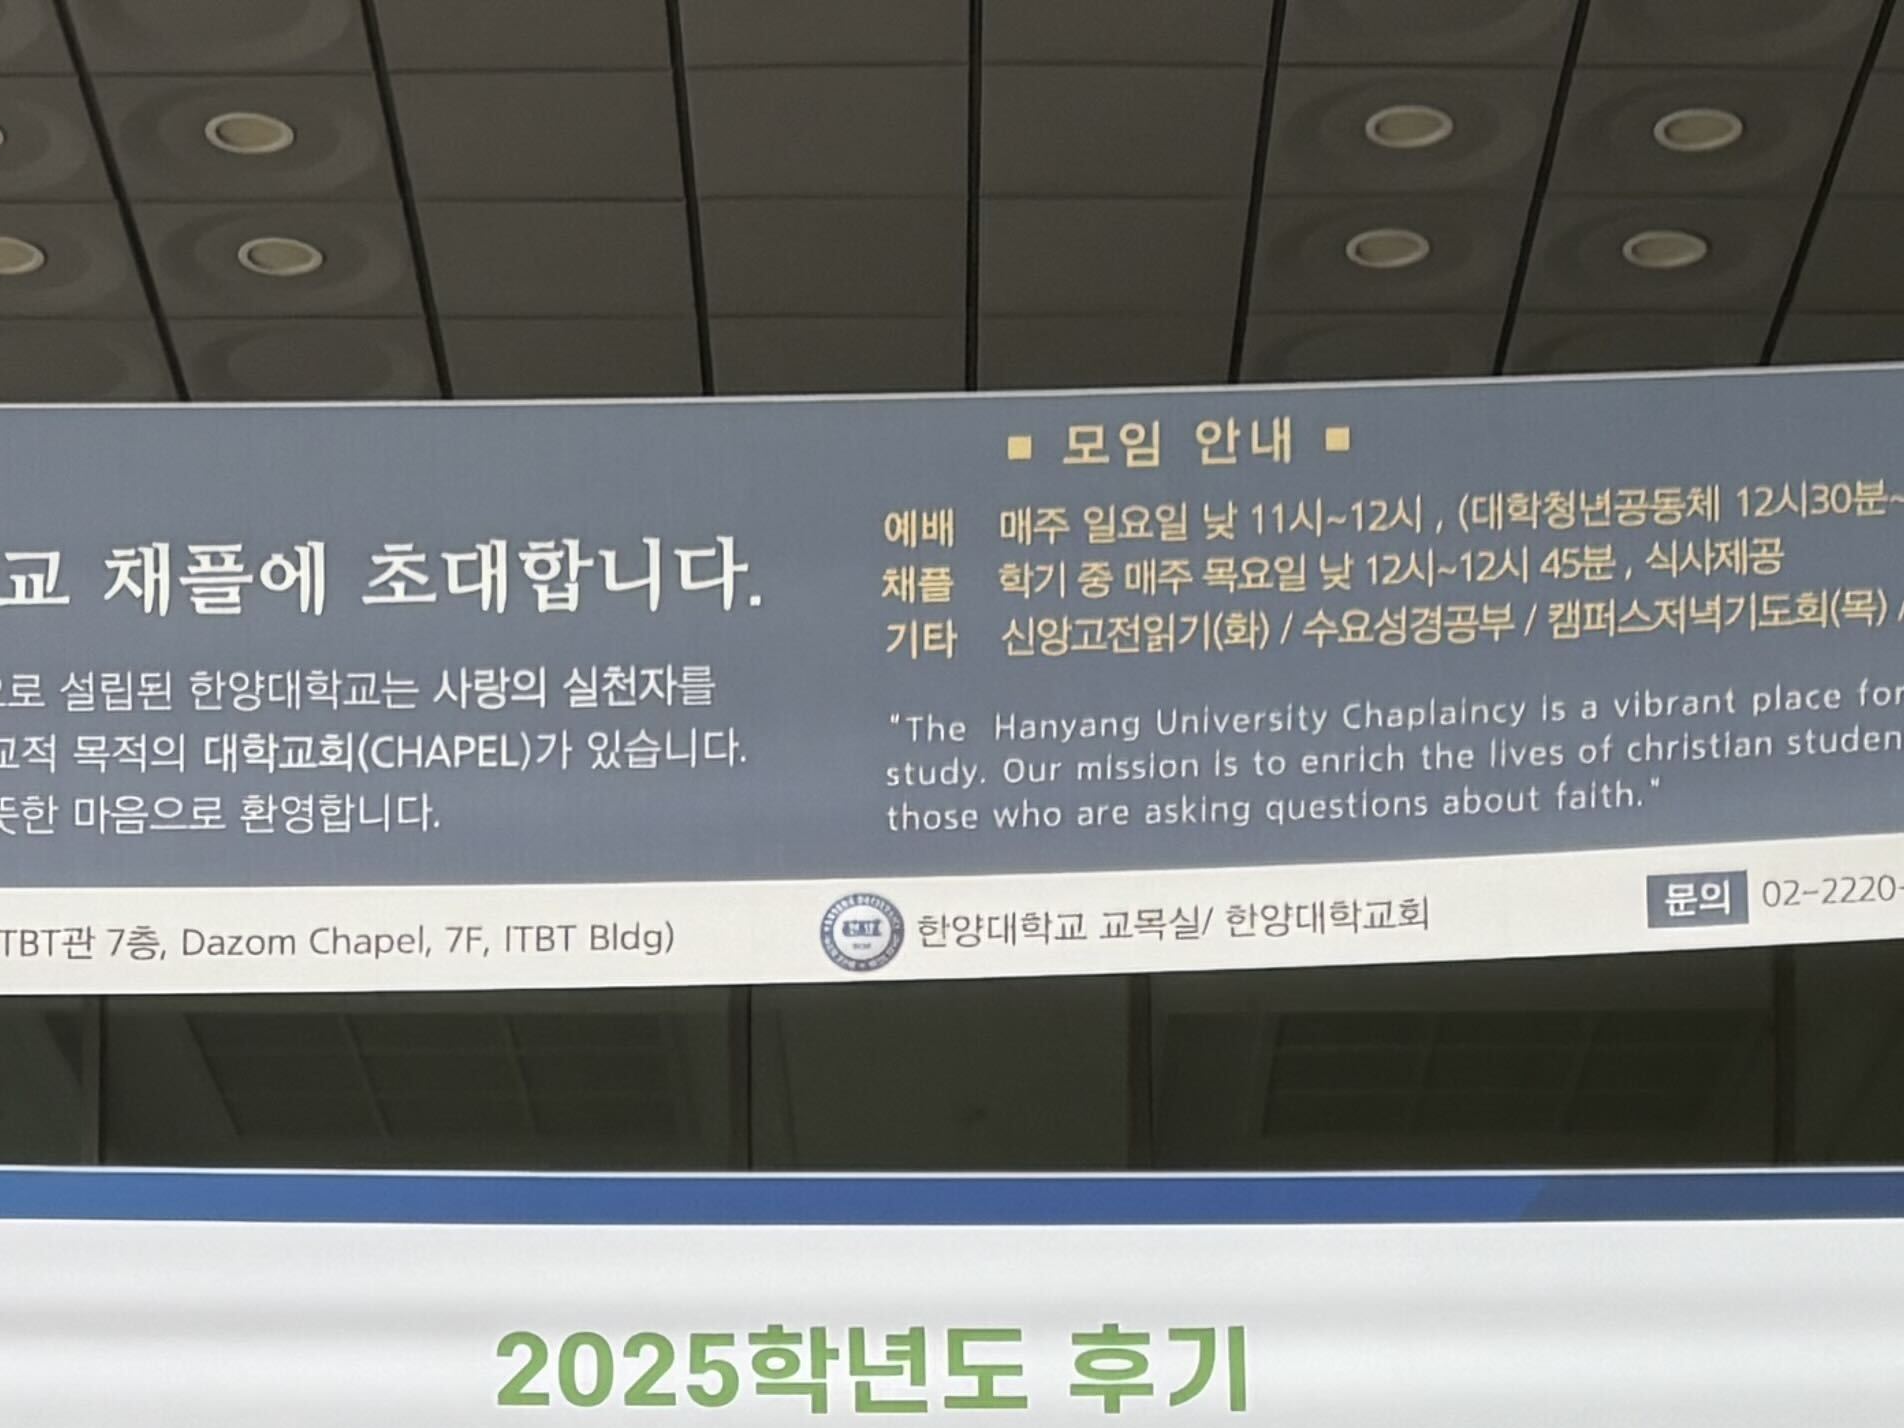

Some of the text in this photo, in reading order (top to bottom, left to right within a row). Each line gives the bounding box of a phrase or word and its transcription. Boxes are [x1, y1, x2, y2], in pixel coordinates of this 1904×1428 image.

[1063, 416, 1290, 467] 모임 안내
[885, 508, 953, 548] 예배
[1001, 507, 1069, 545] 매주
[1084, 502, 1187, 543] 일요일
[1204, 501, 1237, 539] 낮
[1252, 494, 1420, 537] 11시~12시
[1459, 484, 1719, 532] (대학청년공동체
[104, 541, 324, 616] 채플에
[362, 536, 761, 613] 초대합니다.
[882, 566, 953, 603] 채플
[999, 561, 1064, 599] 학기
[1078, 562, 1113, 598] 중
[1125, 558, 1193, 595] 매주
[1203, 553, 1305, 593] 목요일
[1320, 552, 1354, 590] 낮
[1367, 546, 1527, 587] 12시~12시
[1646, 537, 1784, 578] 식사제공
[887, 619, 957, 659] 기타
[1002, 610, 1269, 656] 신앙고전읽기(화)
[1303, 603, 1515, 648] 수요성경공부
[1549, 588, 1887, 639] 캠퍼스저녁기도회(목)
[61, 671, 171, 711] 설립된
[190, 670, 419, 711] 한양대학교는
[434, 667, 545, 709] 사랑의
[564, 664, 715, 707] 실천자를
[891, 712, 967, 743] "The
[995, 708, 1140, 746] Hanyang
[1157, 702, 1328, 742] University
[1342, 694, 1526, 734] Chaplaincy
[1541, 696, 1567, 724] is
[1581, 702, 1599, 722] a
[1613, 688, 1735, 720] vibrant
[1752, 680, 1840, 718] place
[74, 734, 184, 773] 목적의
[205, 730, 572, 773] 대학교회(CHAPEL)가
[588, 728, 746, 769] 있습니다.
[886, 757, 986, 790] study.
[1002, 755, 1061, 785] Our
[1077, 749, 1198, 782] mission
[1214, 749, 1239, 778] is
[1253, 748, 1286, 776] to
[1301, 742, 1403, 774] enrich
[1420, 740, 1474, 769] the
[1489, 737, 1564, 767] lives
[1578, 733, 1614, 763] of
[1627, 726, 1773, 763] christian
[75, 795, 226, 834] 마음으로
[240, 793, 439, 833] 환영합니다.
[886, 778, 1662, 831] those who are asking questions about faith."
[916, 910, 1086, 950] 한양대학교
[1099, 904, 1215, 944] 교목실/
[1226, 898, 1429, 938] 한양대학교회
[1665, 880, 1731, 917] 문의
[107, 928, 167, 966] 7층,
[182, 928, 296, 960] Dazom
[309, 926, 431, 964] Chapel,
[446, 927, 490, 962] 7F,
[505, 925, 577, 953] ITBT
[588, 921, 676, 962] Bldg)
[497, 1323, 1246, 1414] 2025학년도 후기
